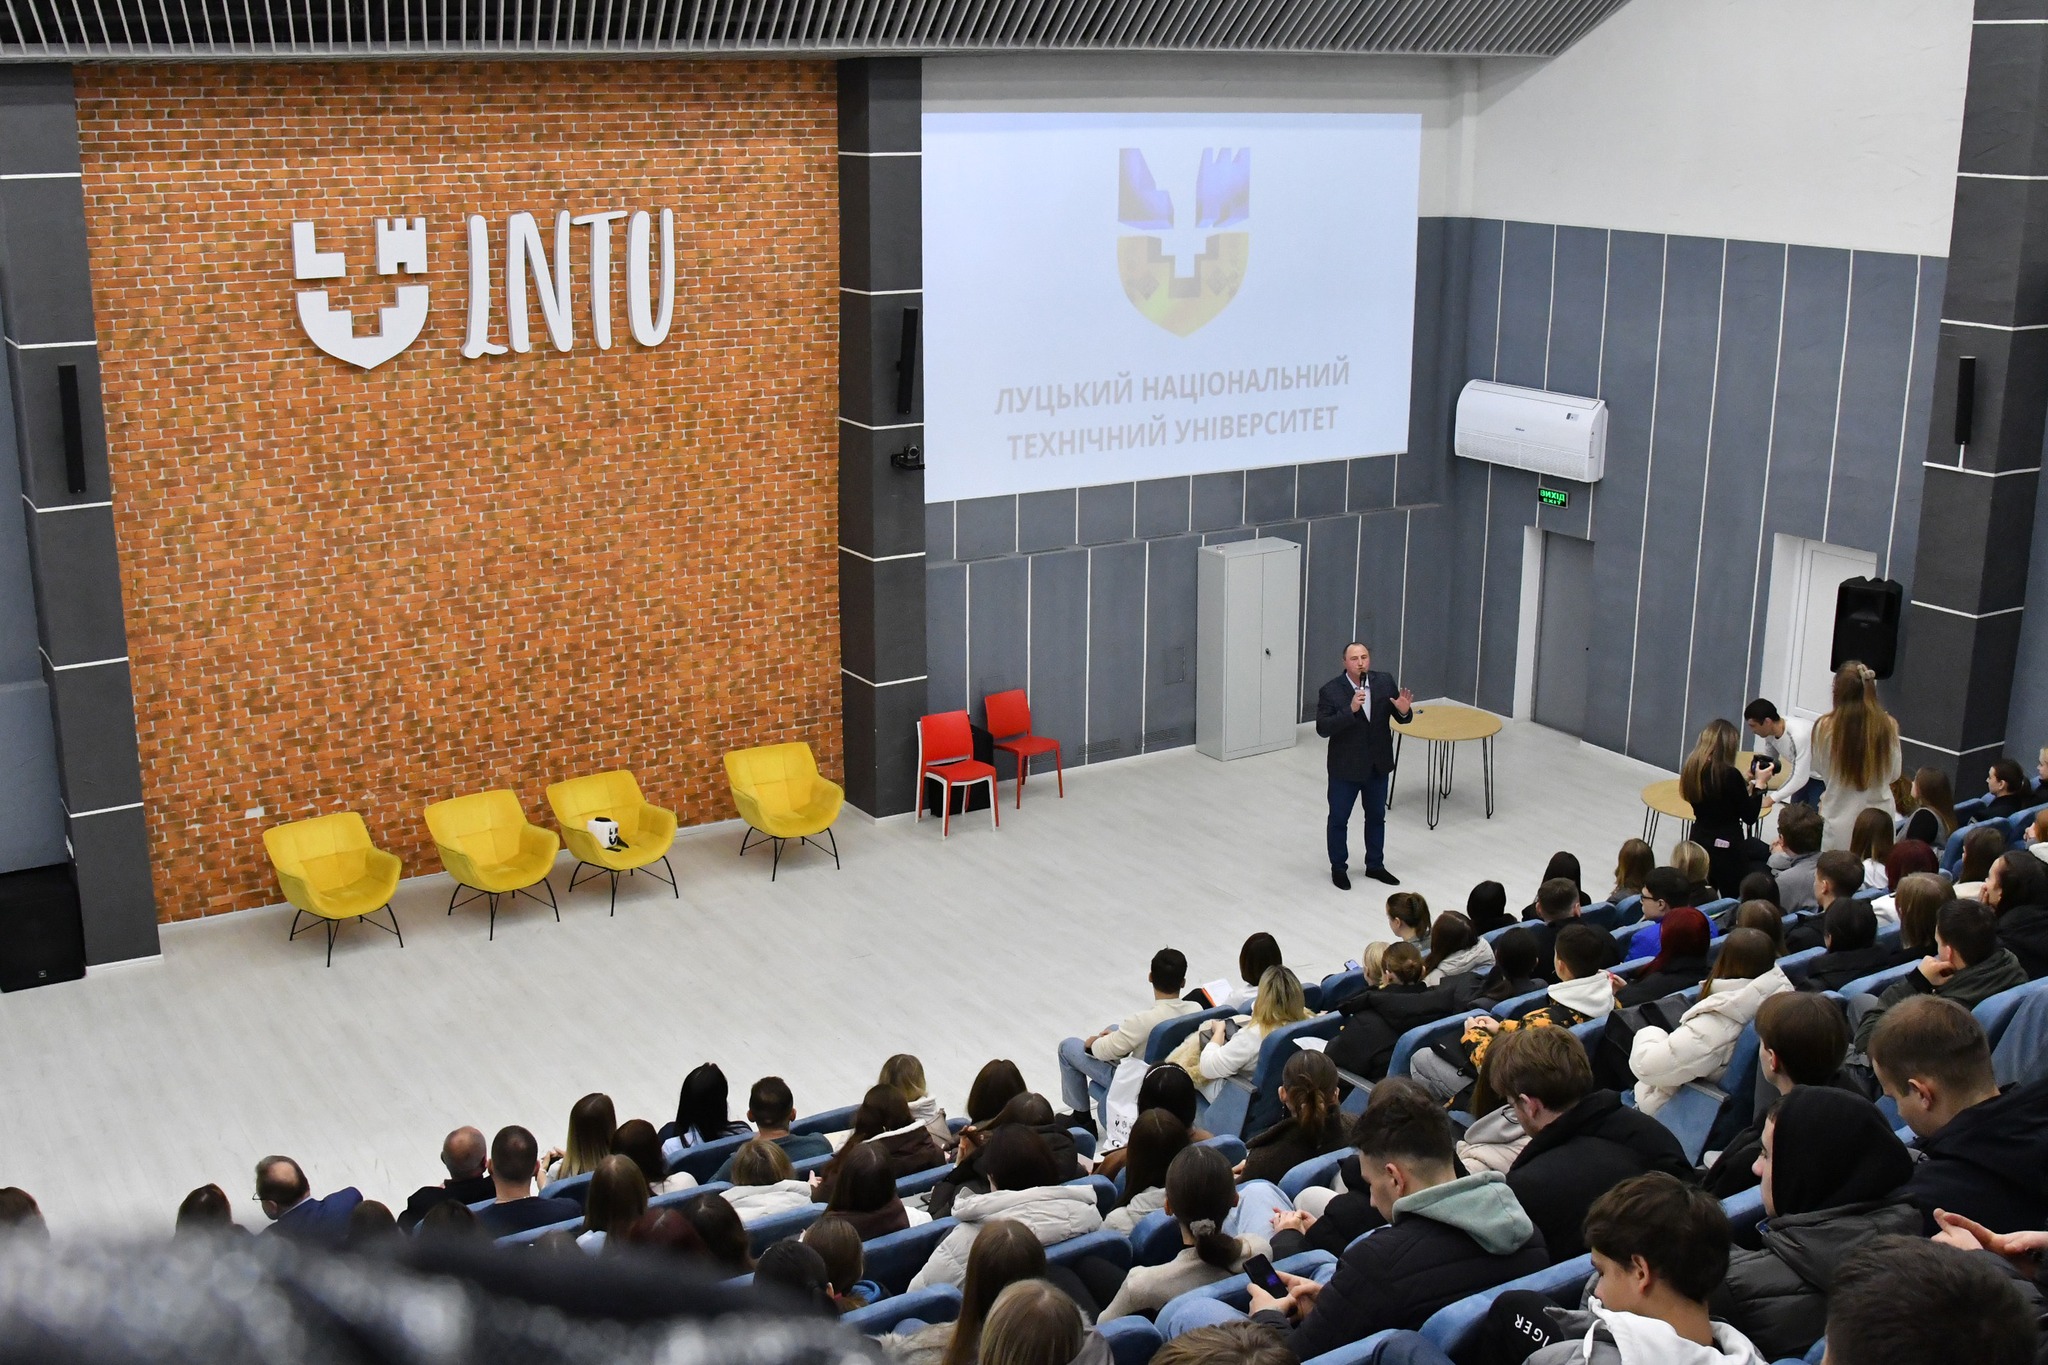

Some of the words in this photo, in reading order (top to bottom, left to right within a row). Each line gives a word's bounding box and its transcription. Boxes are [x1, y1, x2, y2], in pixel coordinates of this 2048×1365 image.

[994, 370, 1133, 417] ЛУЦЬКИЙ
[1141, 355, 1350, 405] НАЦІОНАЛЬНИЙ
[1006, 414, 1167, 461] ТЕХНІЧНИЙ
[1173, 405, 1340, 446] УНІВЕРСИТЕТ
[1540, 489, 1565, 502] ВИХІД
[1514, 1313, 1550, 1348] IGER
